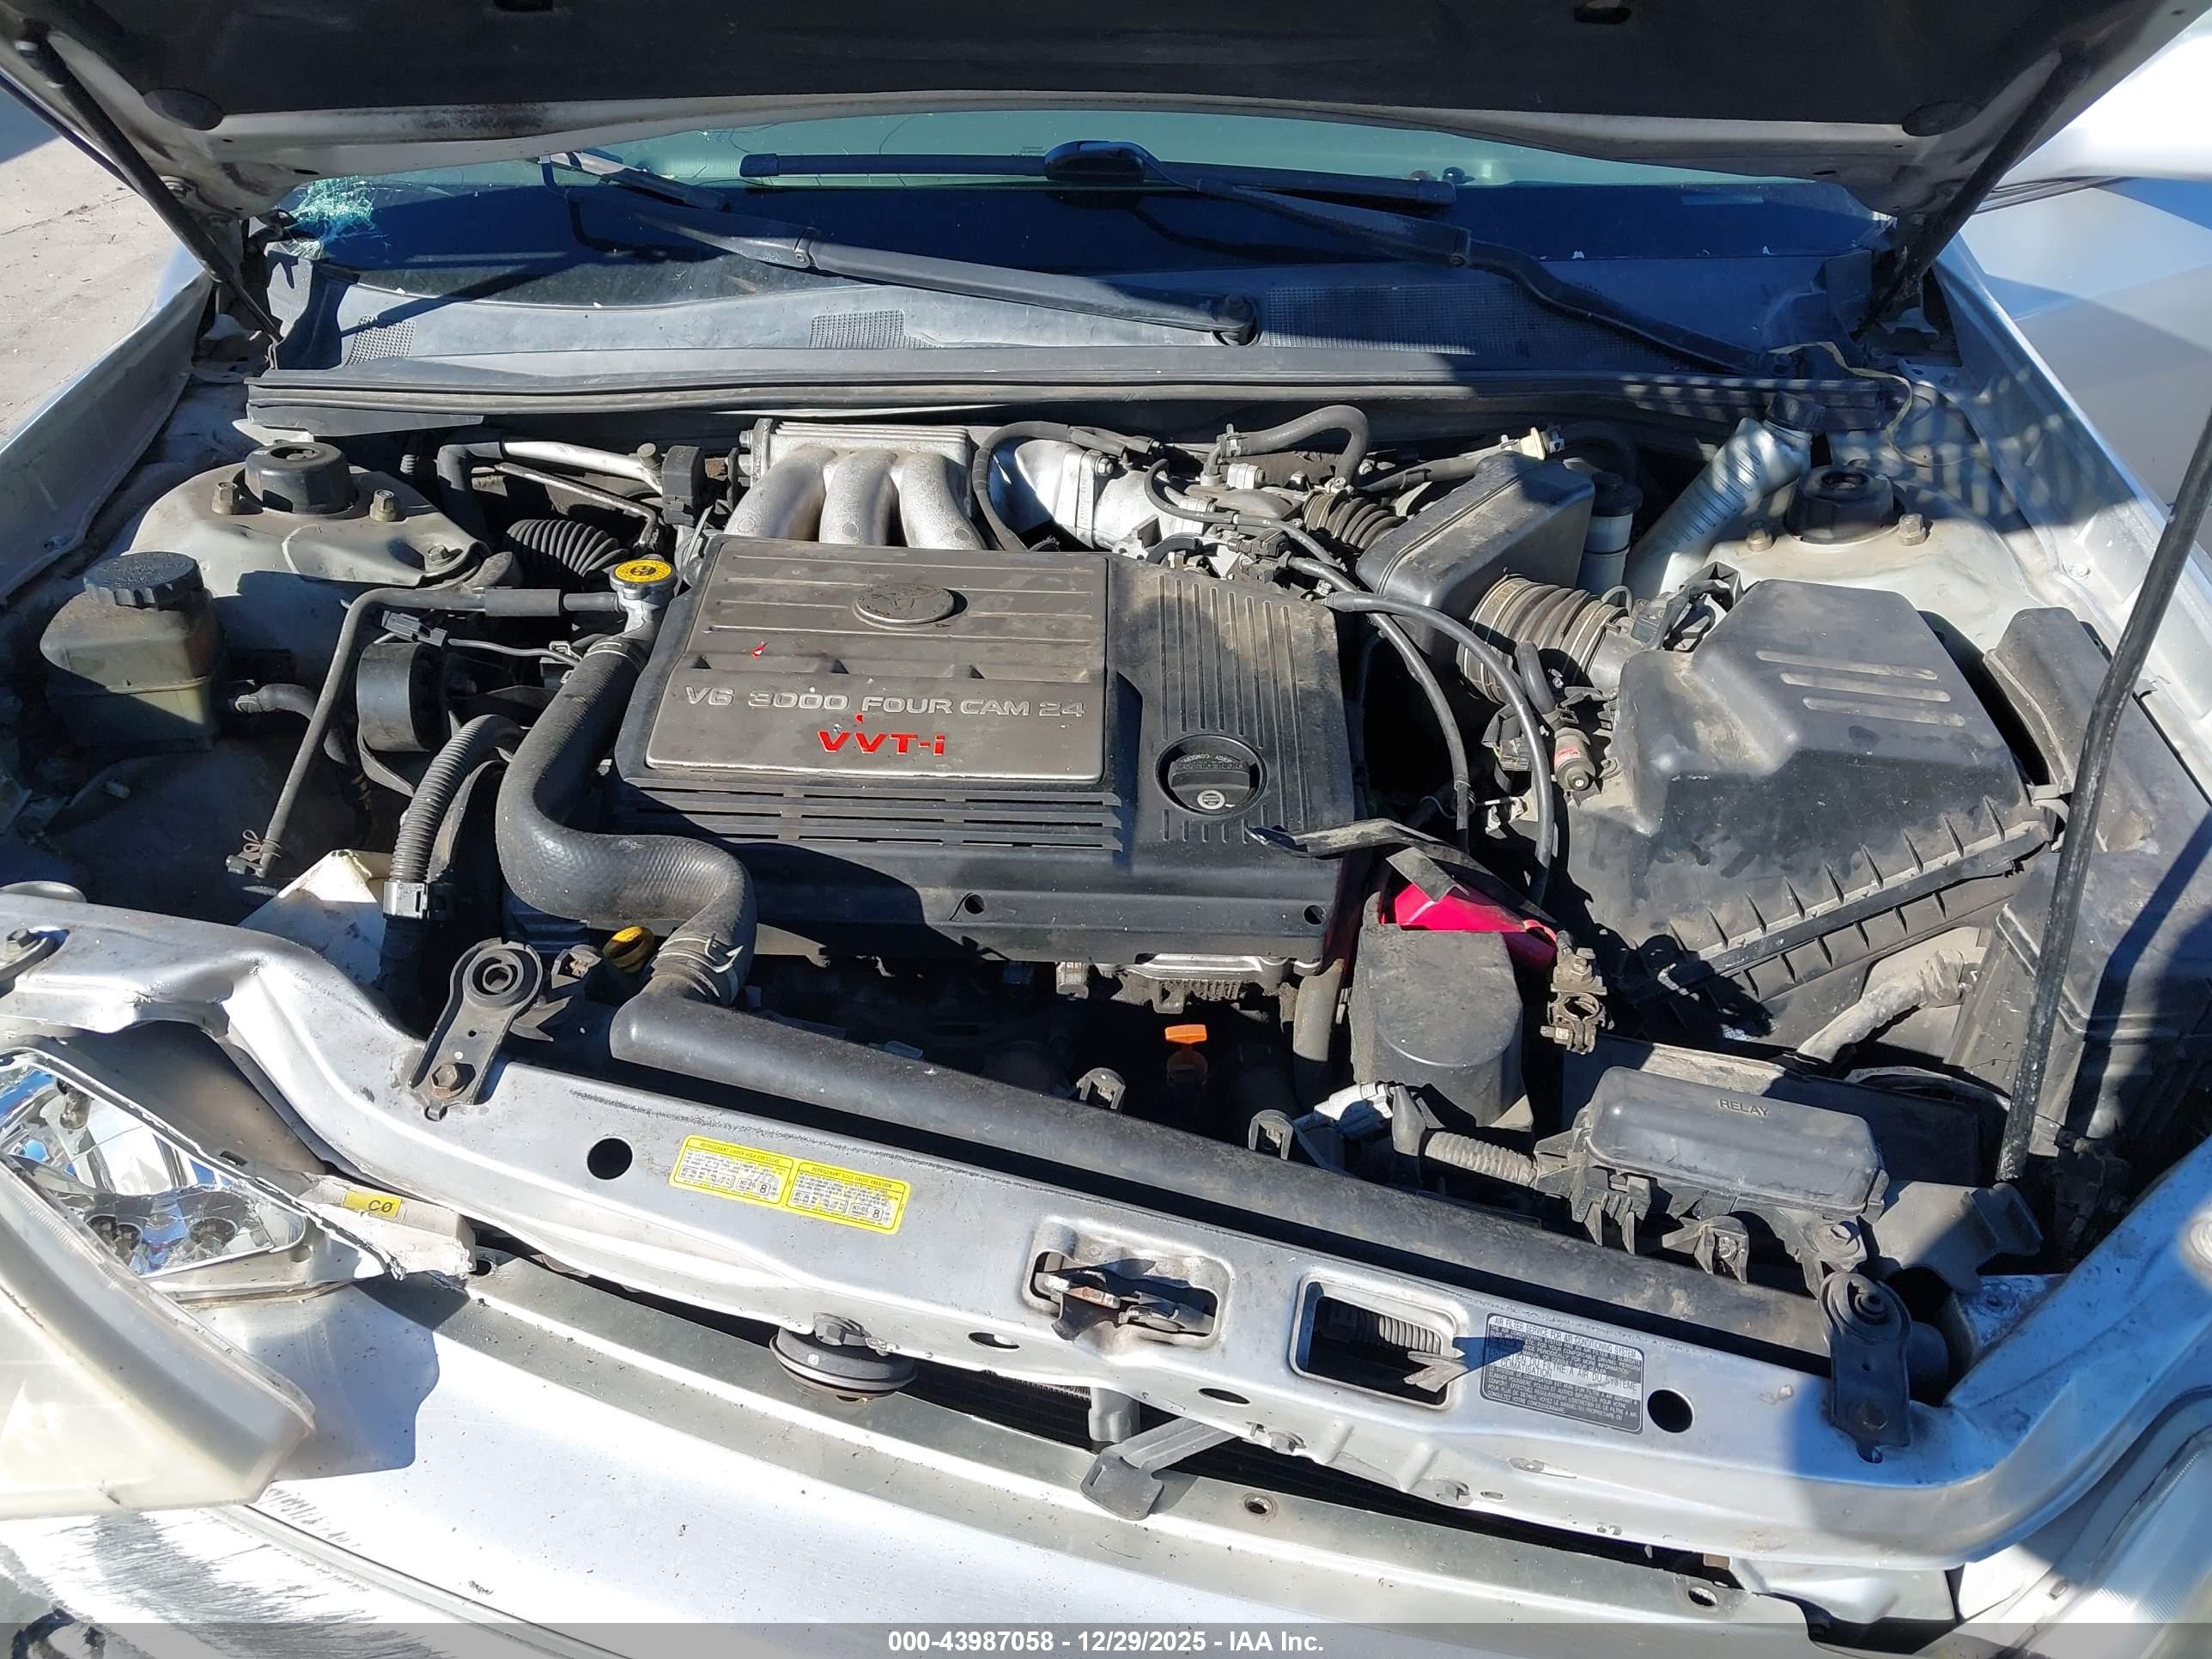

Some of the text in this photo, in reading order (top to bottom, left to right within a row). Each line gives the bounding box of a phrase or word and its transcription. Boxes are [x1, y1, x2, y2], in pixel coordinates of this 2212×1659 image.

[686, 686, 1085, 718] V6 3000 FOUR CAM 24
[817, 731, 945, 757] VVT-i
[1718, 1098, 1769, 1117] RELAY
[760, 1184, 767, 1194] 8
[872, 1209, 880, 1219] 8
[1495, 1316, 1635, 1358] AIR FILTER SERVICE FOR AIR CONDITIONING SYSTEM
[1543, 1361, 1565, 1373] FILTRE
[1577, 1369, 1588, 1378] AIR
[1593, 1373, 1601, 1382] DU
